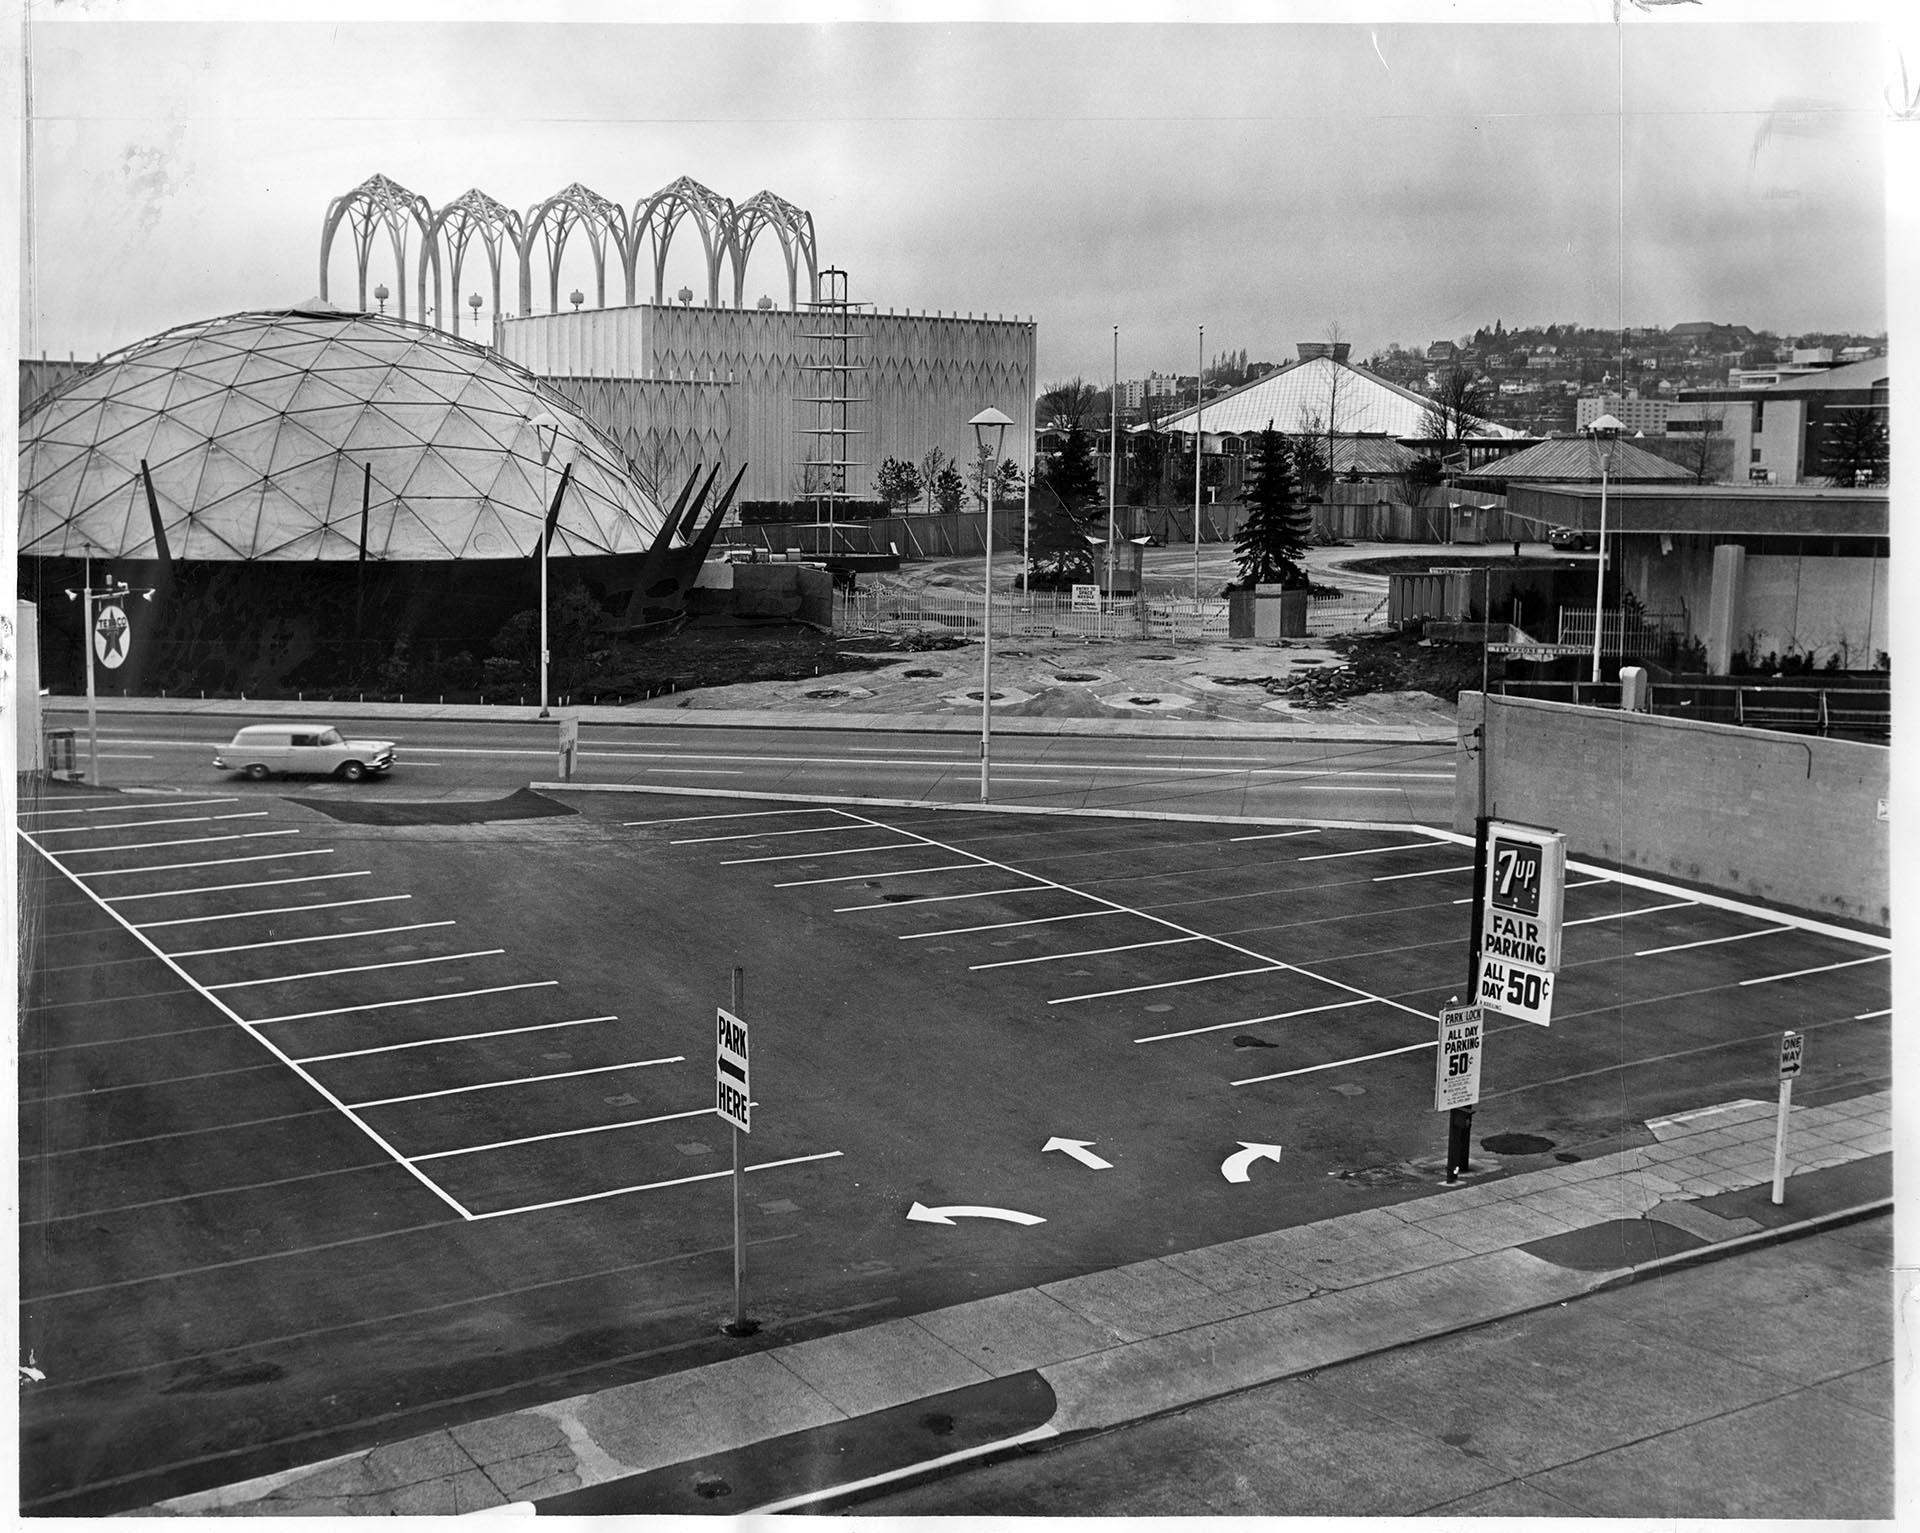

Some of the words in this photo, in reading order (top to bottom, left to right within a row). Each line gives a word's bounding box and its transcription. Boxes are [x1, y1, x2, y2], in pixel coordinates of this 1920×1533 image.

[1493, 915, 1538, 943] FAIR
[1485, 933, 1546, 965] PARKING
[1484, 962, 1505, 982] ALL
[1482, 980, 1504, 1000] DAY
[1507, 969, 1550, 1010] 50¢
[1445, 1013, 1463, 1025] PARK
[1466, 1009, 1481, 1020] LOCK
[719, 1015, 747, 1060] PARK
[1448, 1029, 1462, 1041] ALL
[1465, 1026, 1479, 1038] DAY
[1784, 1036, 1802, 1050] ONE
[1445, 1037, 1480, 1055] PARKING
[1782, 1050, 1801, 1063] WAY
[719, 1081, 748, 1125] HERE
